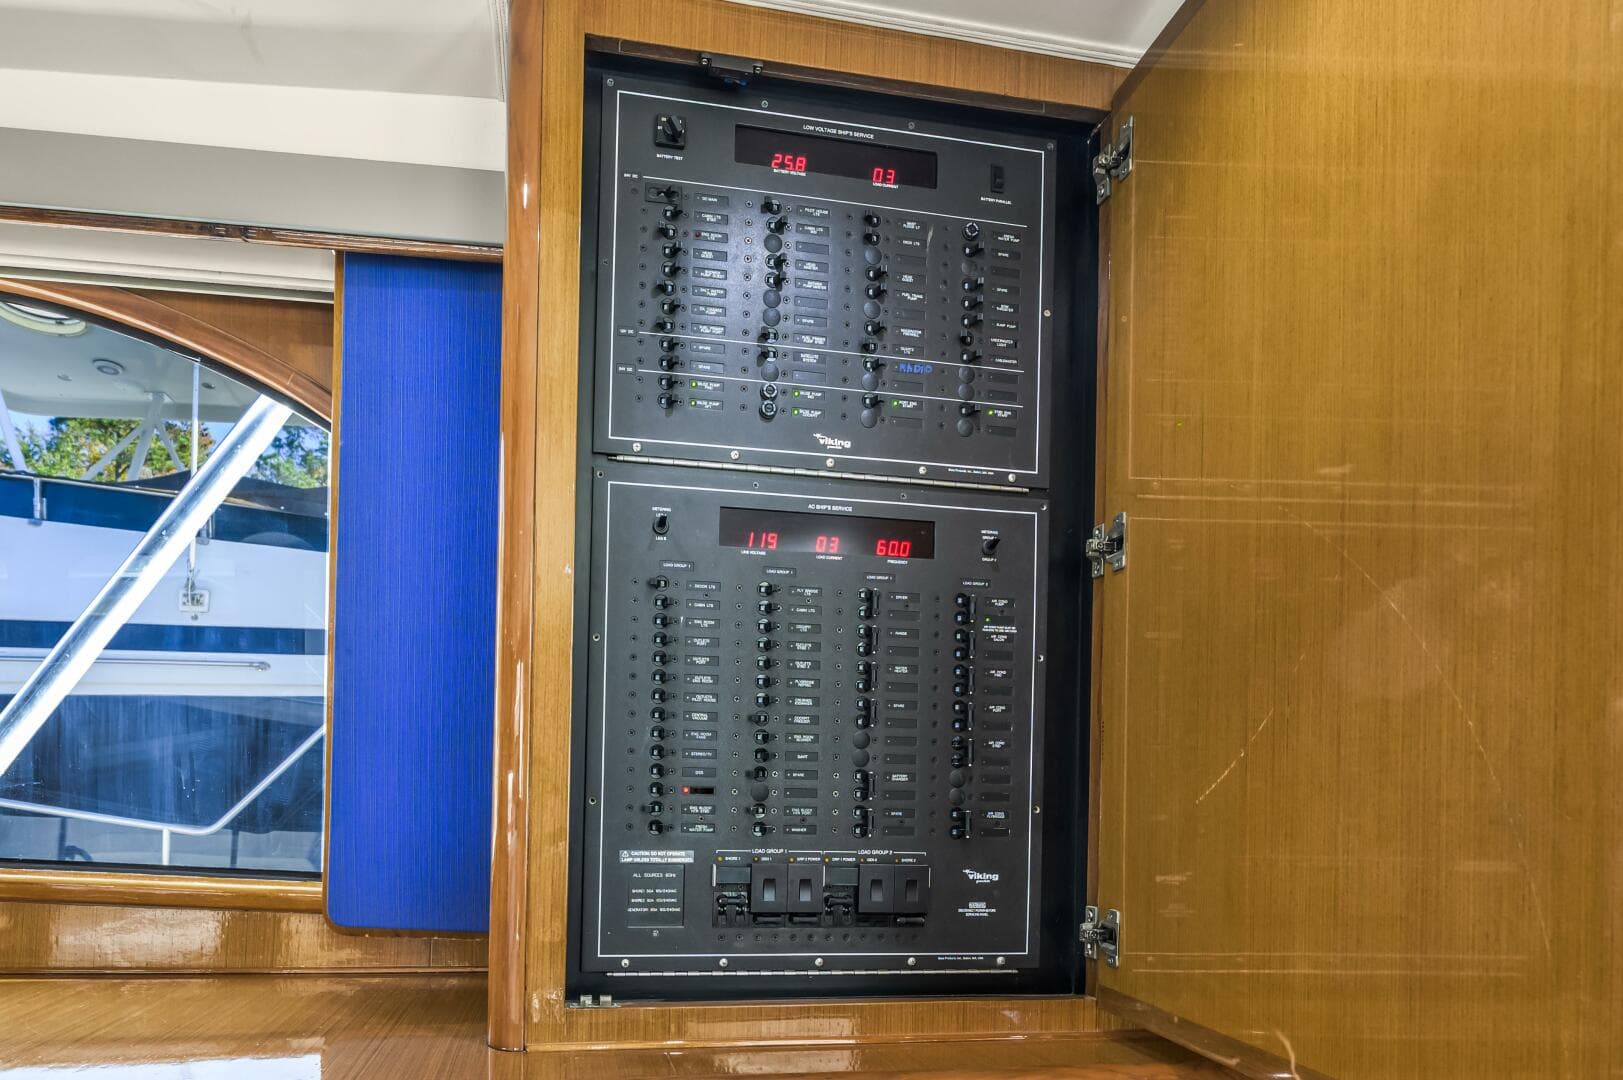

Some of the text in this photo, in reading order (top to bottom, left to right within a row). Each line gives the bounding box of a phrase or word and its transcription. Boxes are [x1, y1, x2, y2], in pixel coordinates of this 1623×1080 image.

[802, 123, 815, 131] LOW
[816, 125, 837, 134] VOLTAGE
[853, 130, 874, 139] SERVICE
[898, 362, 933, 374] RADIO
[817, 436, 852, 449] viking
[748, 531, 778, 549] 119
[968, 873, 999, 881] viking
